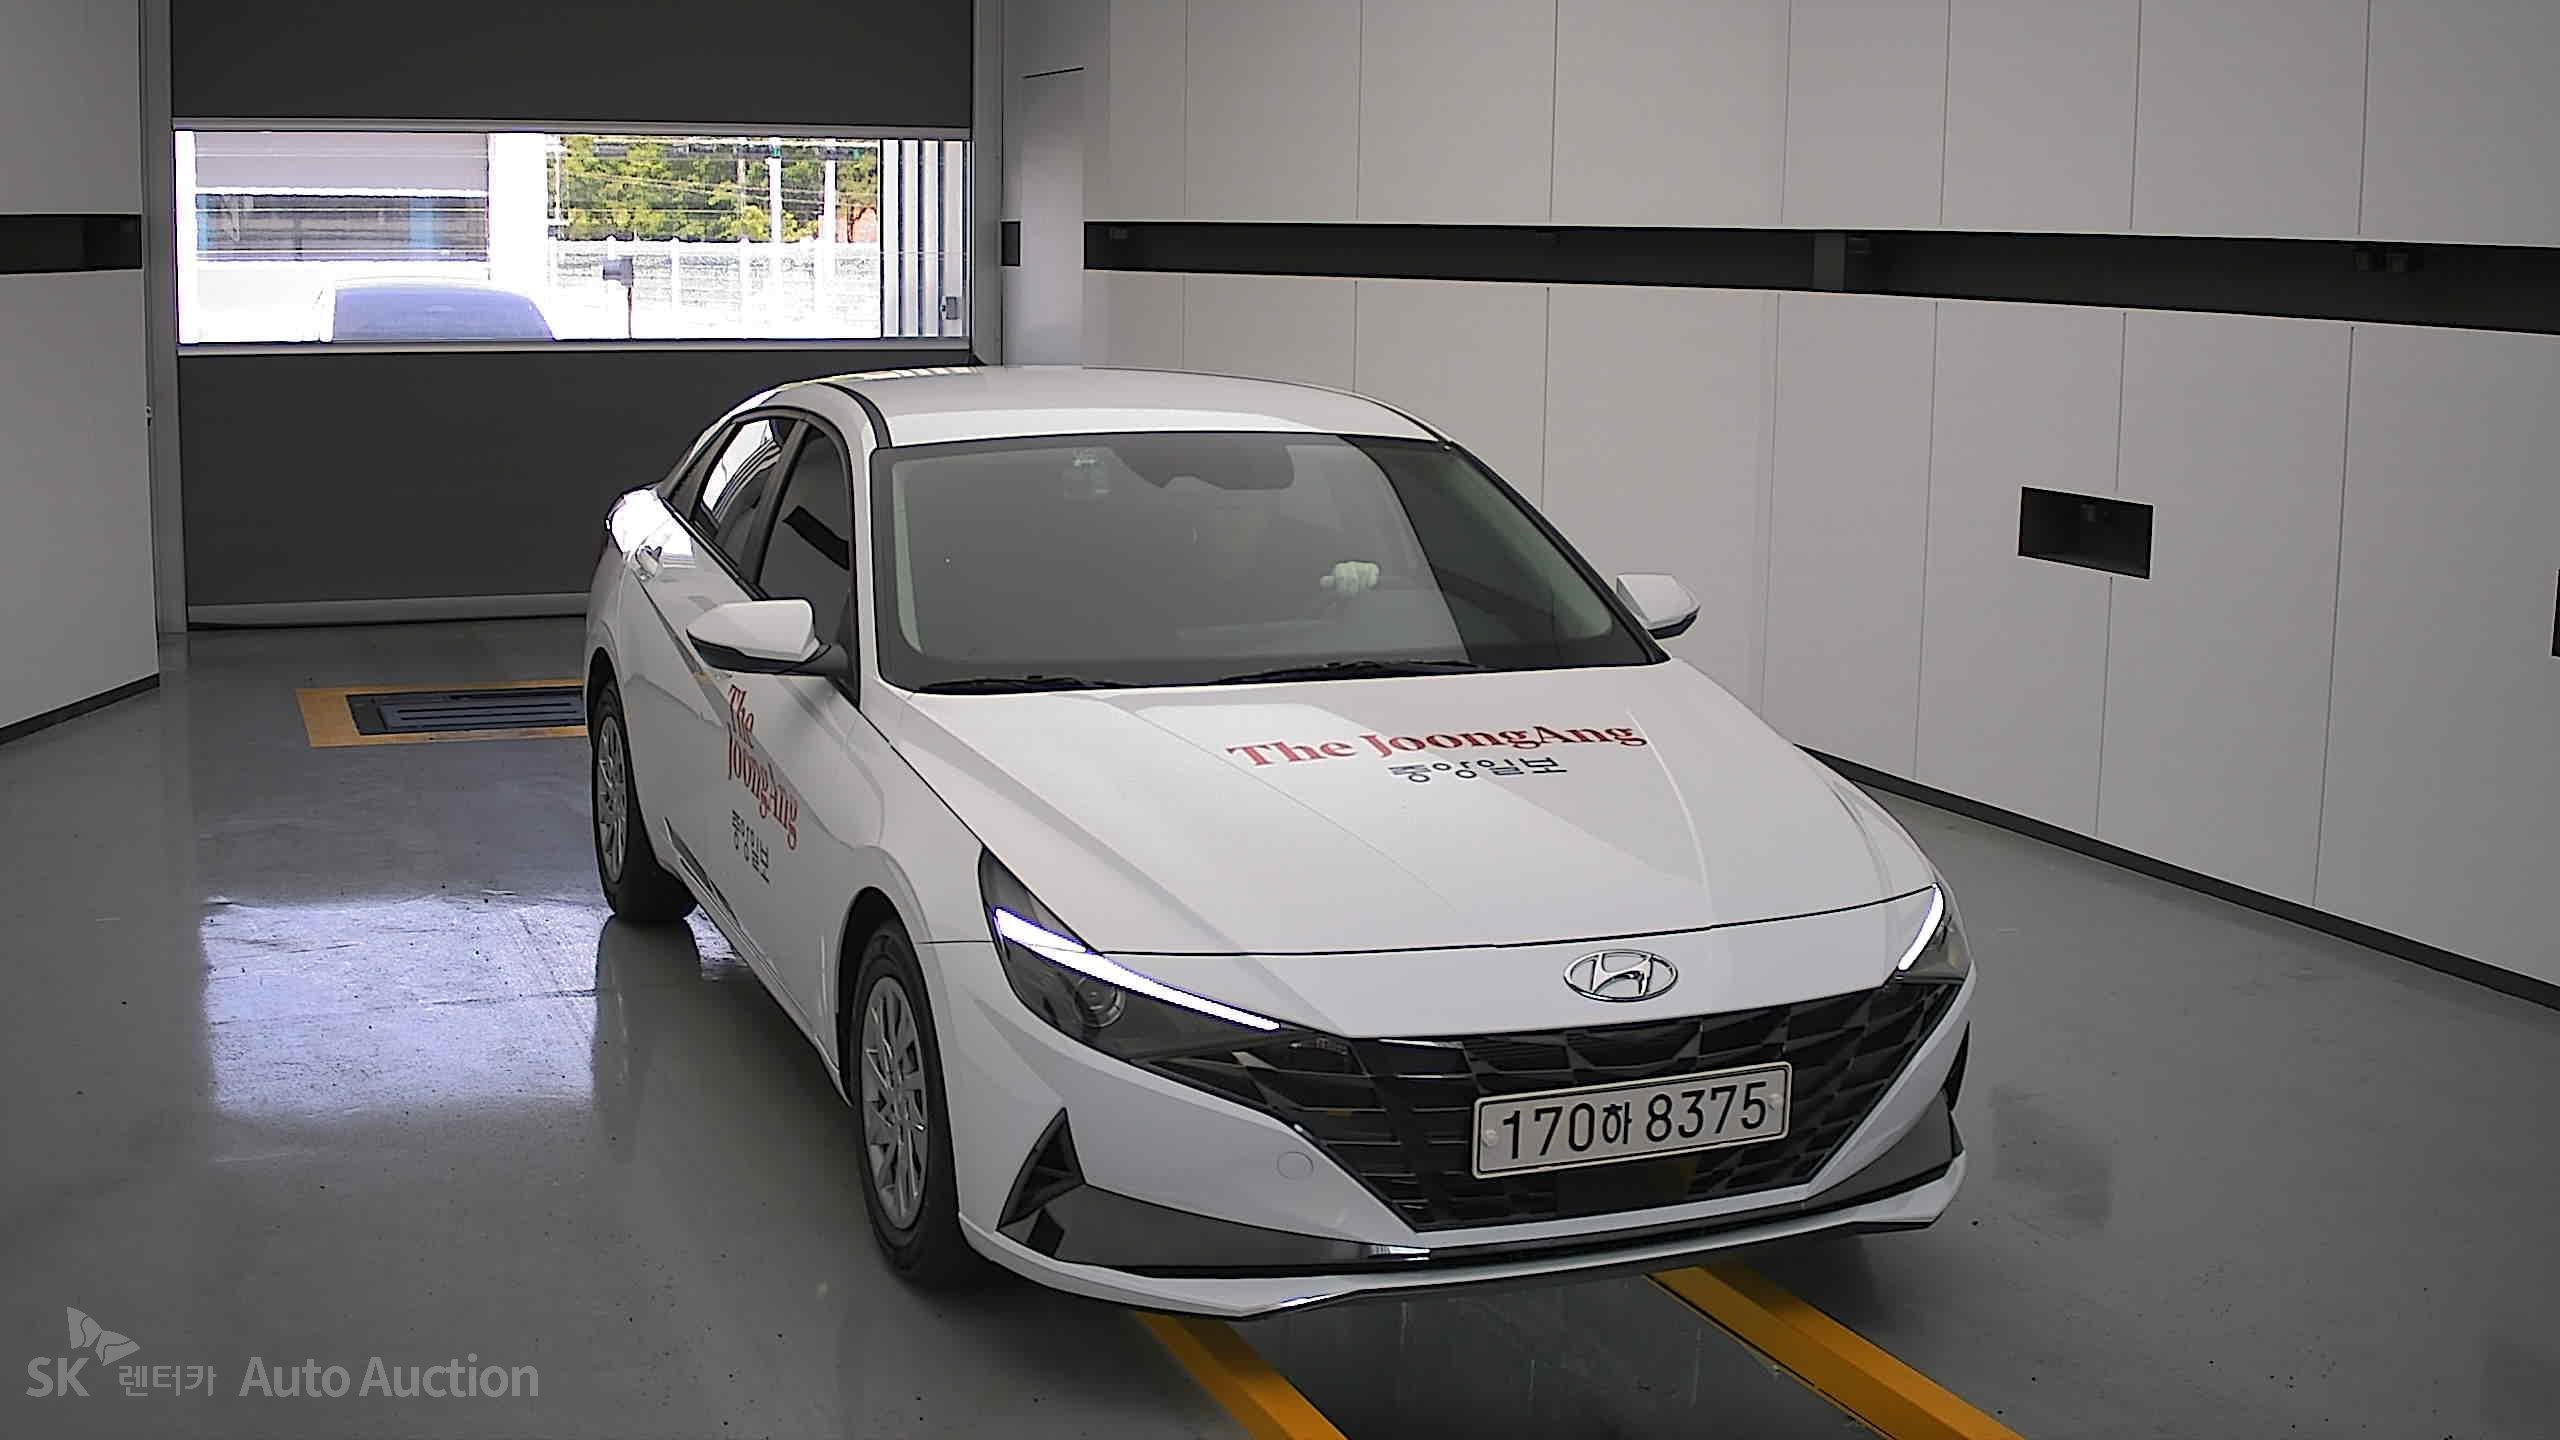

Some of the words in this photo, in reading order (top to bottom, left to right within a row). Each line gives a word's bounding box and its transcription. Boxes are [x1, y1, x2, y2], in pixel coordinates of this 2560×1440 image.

[728, 684, 754, 749] The
[1226, 740, 1358, 767] The
[1359, 725, 1648, 758] JoongAng
[1388, 756, 1567, 784] 중앙일보
[1502, 1102, 1633, 1160] 170하
[1645, 1081, 1767, 1143] 8375
